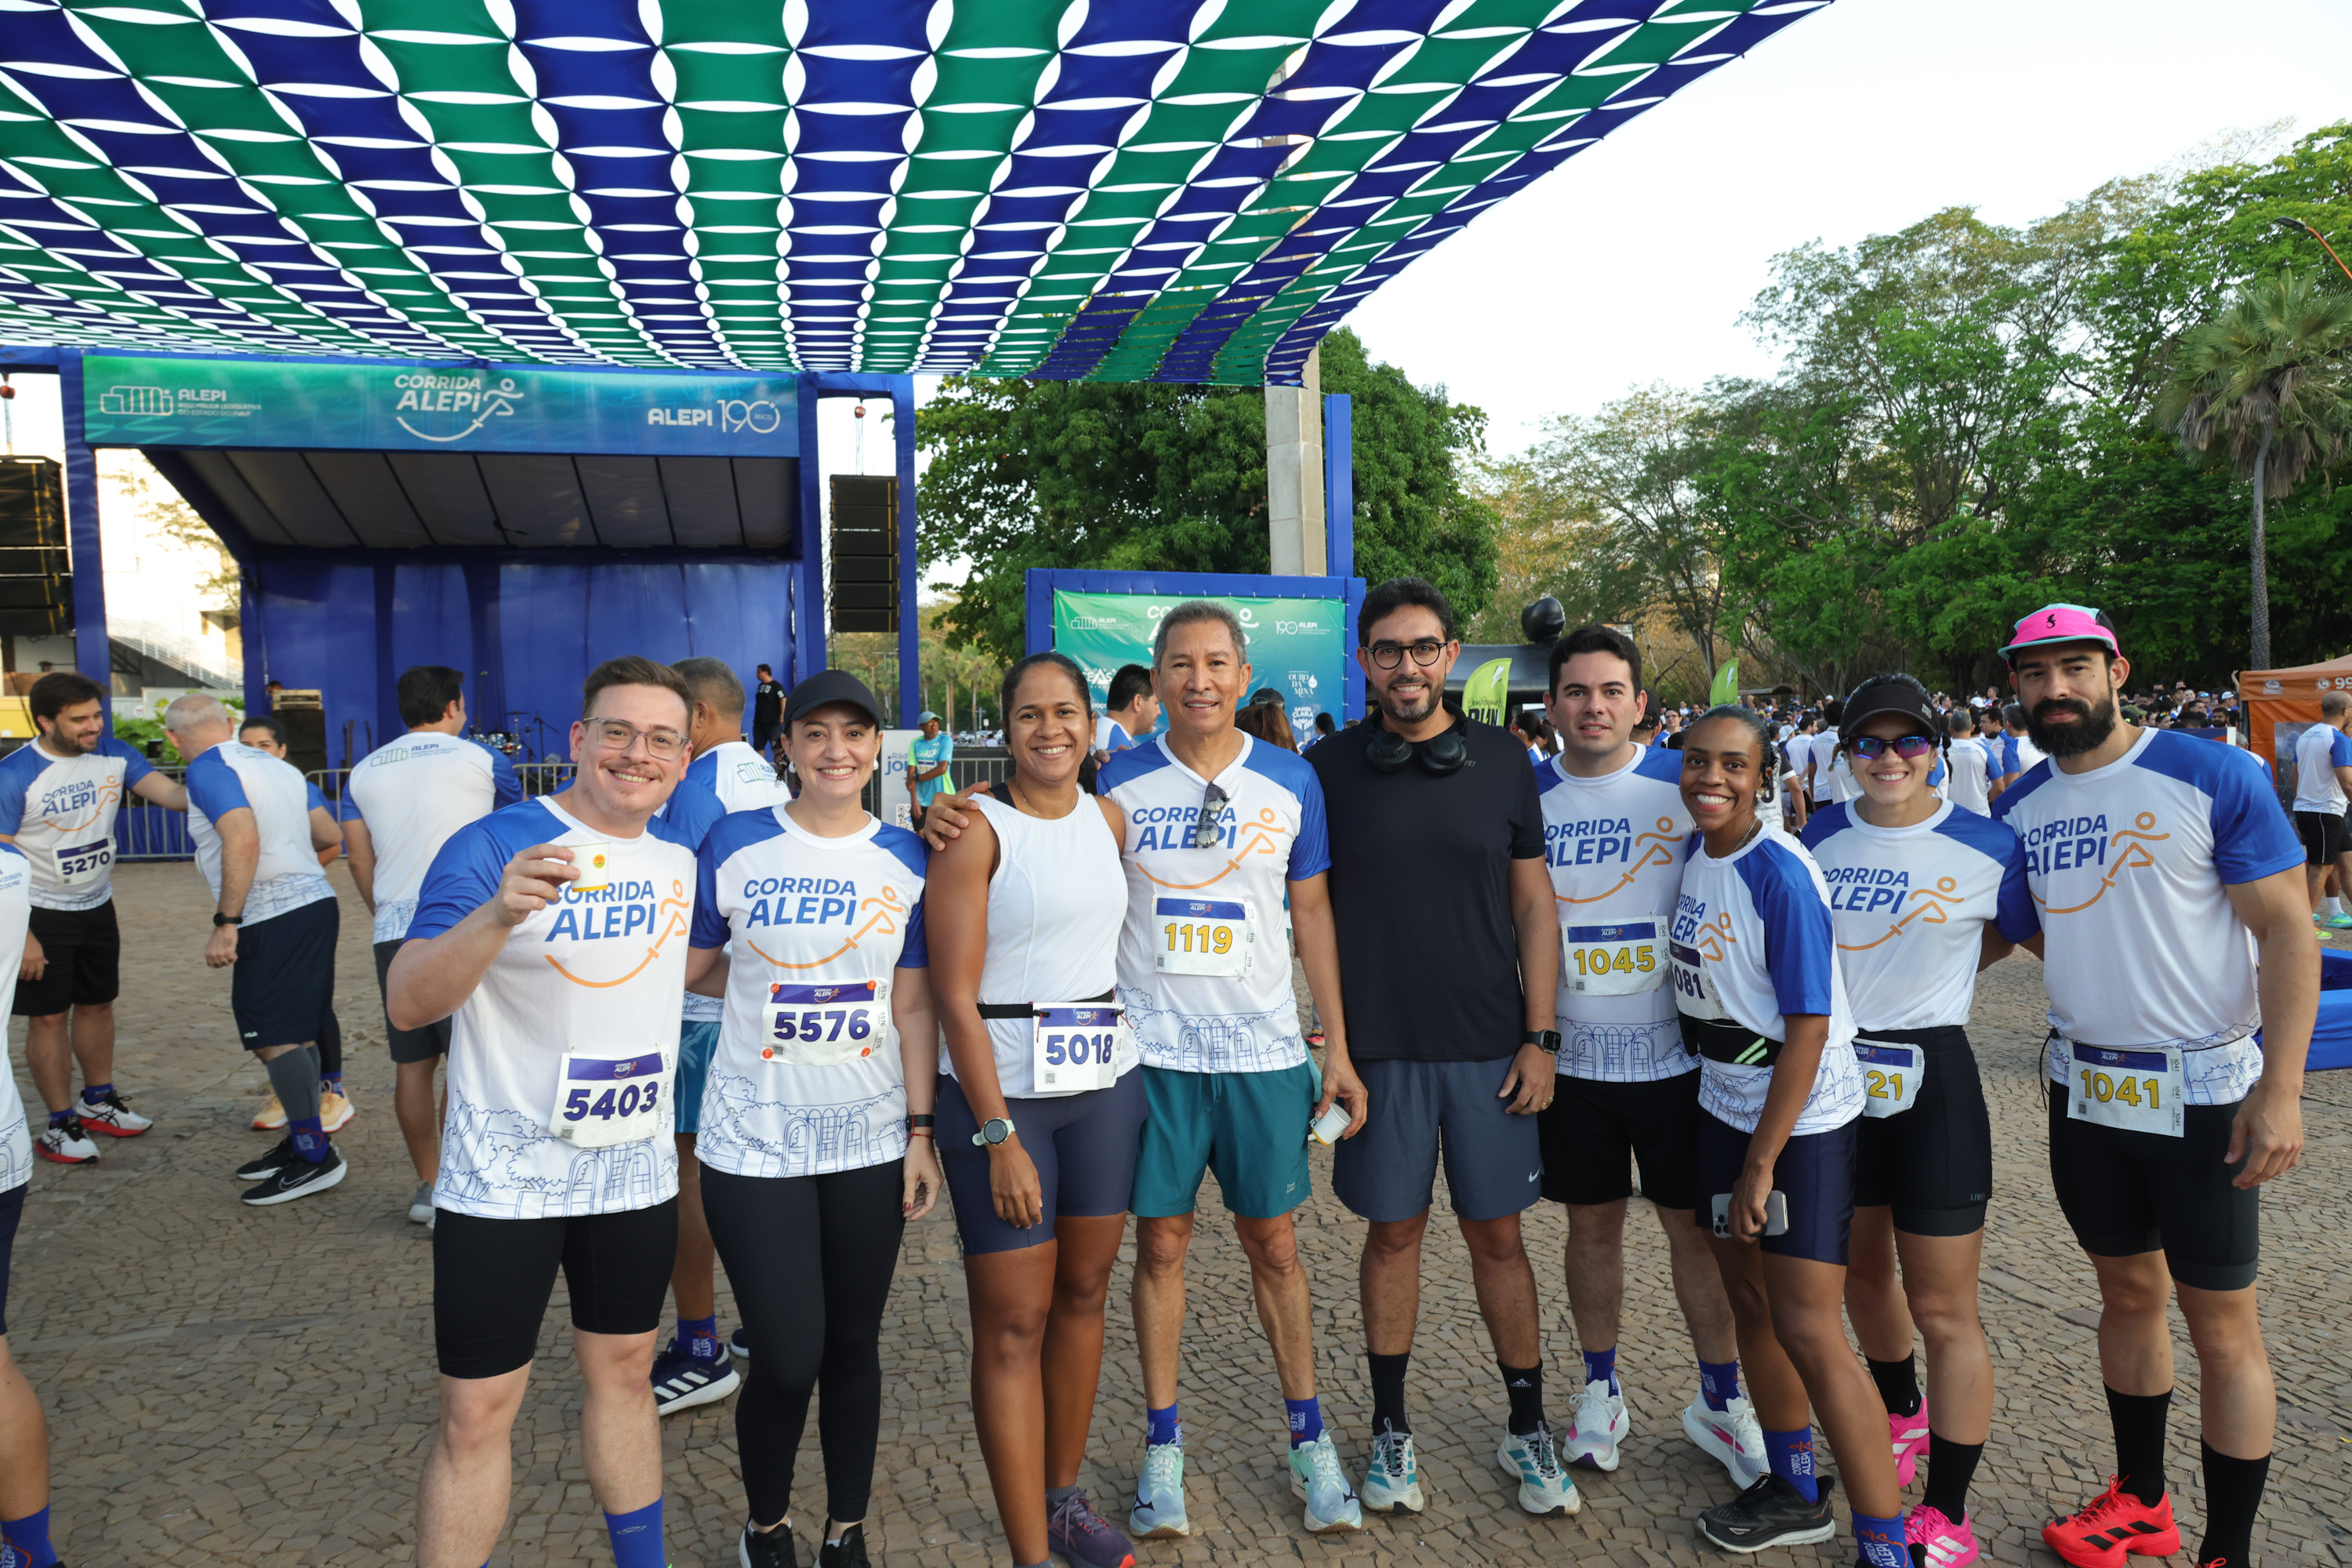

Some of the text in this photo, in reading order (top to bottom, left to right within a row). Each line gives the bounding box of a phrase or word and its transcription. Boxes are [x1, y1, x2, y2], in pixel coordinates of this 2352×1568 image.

[178, 389, 227, 401] ALEPI
[394, 375, 481, 390] CORRIDA
[395, 390, 481, 412] ALEPI
[648, 399, 781, 434] ALEPI 190
[412, 743, 439, 752] ALEPI
[42, 780, 95, 804] CORRIDA
[42, 790, 96, 817] ALEPI
[1544, 818, 1631, 841] ORRIDA
[62, 851, 111, 875] 5270
[744, 877, 857, 898] CORRIDA
[1831, 885, 1907, 914] LEPI
[544, 903, 656, 942] ALEPI
[746, 897, 857, 928] ALEPI
[1165, 923, 1233, 954] 1119
[1574, 946, 1655, 975] 1045
[1674, 964, 1706, 1000] 081
[773, 1009, 871, 1043] 5576
[1046, 1033, 1113, 1065] 5018
[564, 1081, 659, 1121] 5403
[2081, 1069, 2159, 1109] 1041
[701, 1338, 712, 1356] ALEPI
[1801, 1451, 1811, 1475] ALEPI
[1874, 1544, 1900, 1568] ALEPI
